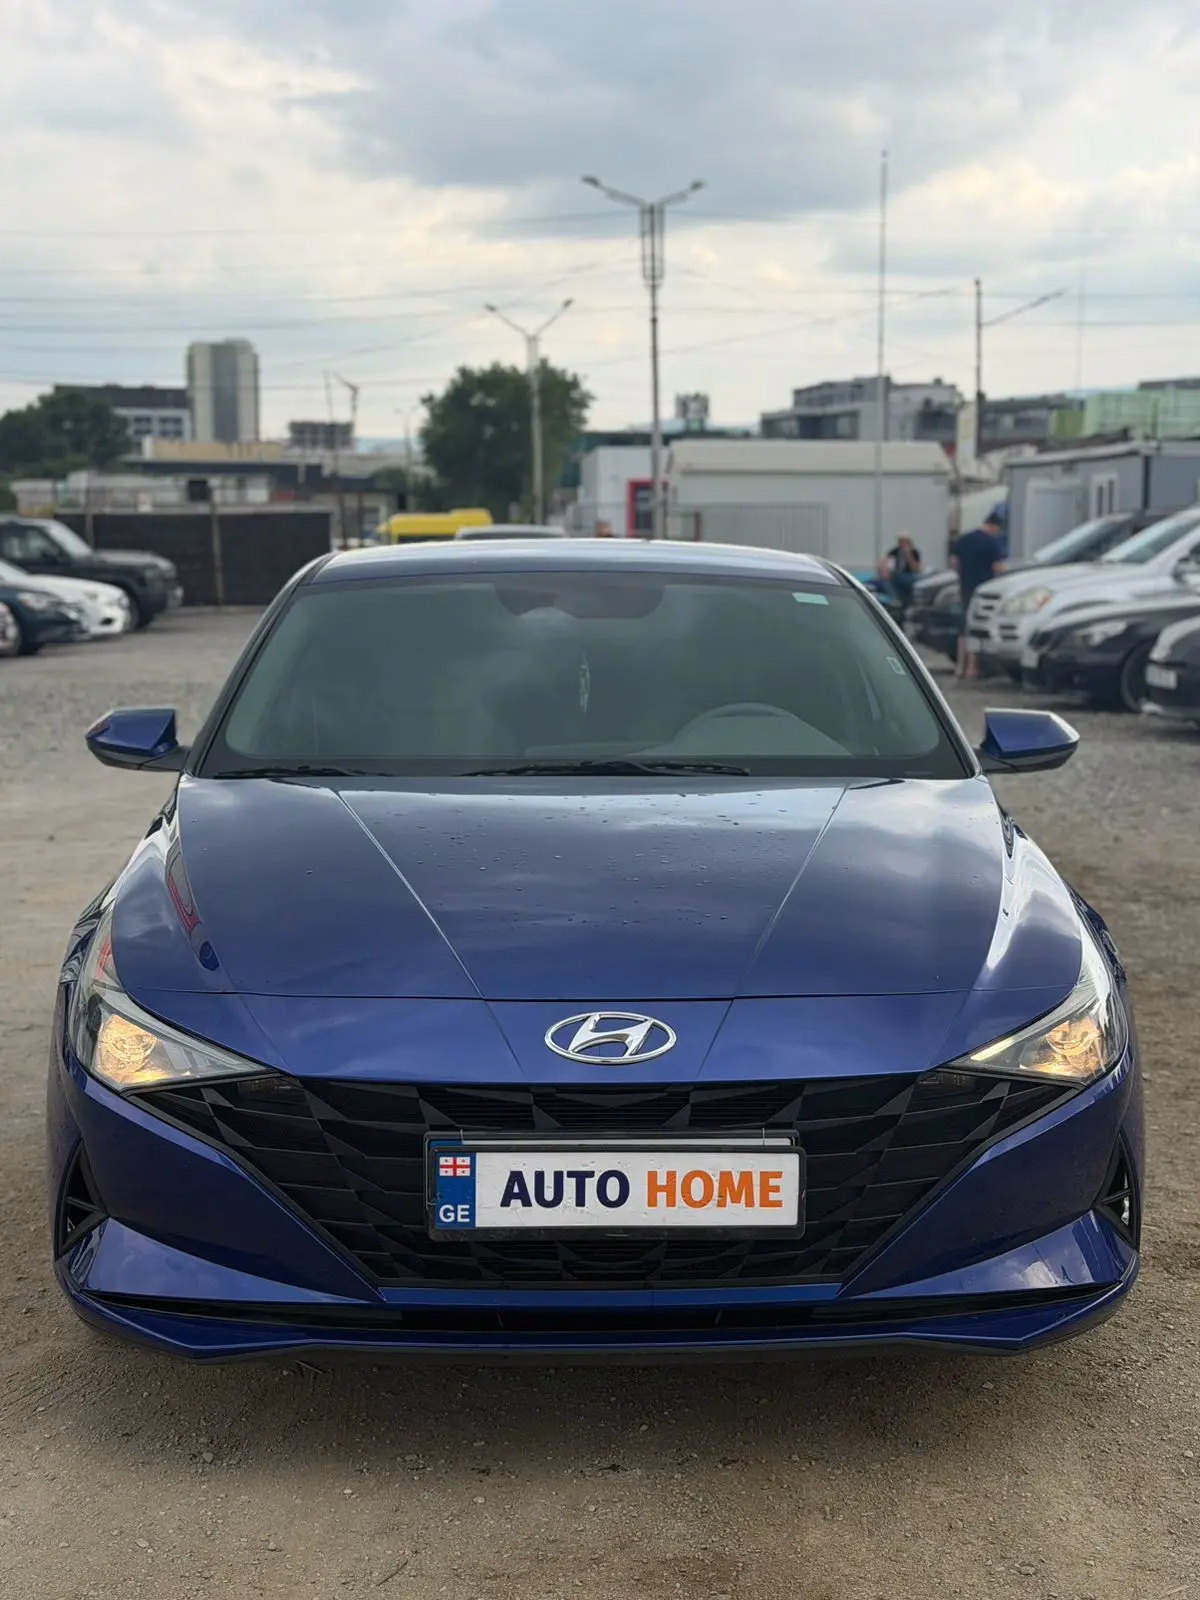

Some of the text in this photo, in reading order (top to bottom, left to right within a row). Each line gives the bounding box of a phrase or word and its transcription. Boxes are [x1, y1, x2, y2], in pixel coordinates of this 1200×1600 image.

[500, 1170, 783, 1208] AUTO HOME
[439, 1204, 470, 1223] GE
